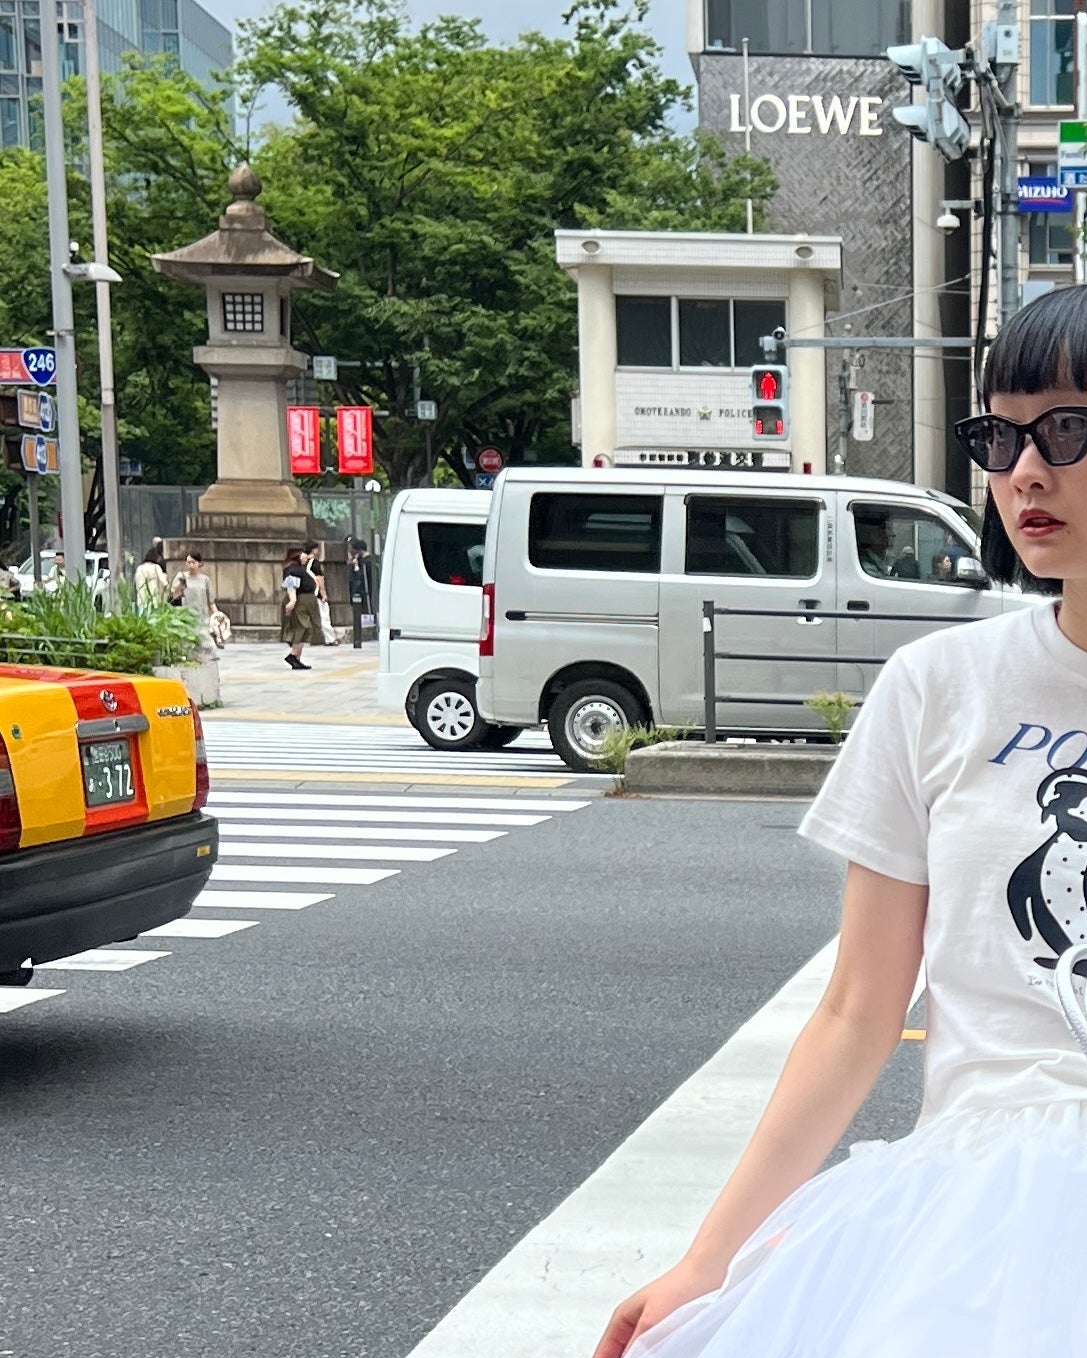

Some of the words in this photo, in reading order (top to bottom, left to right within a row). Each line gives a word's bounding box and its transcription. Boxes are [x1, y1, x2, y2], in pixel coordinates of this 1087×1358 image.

[730, 94, 882, 135] LOEWE
[1018, 185, 1068, 198] MIZUHO
[28, 352, 55, 372] 246
